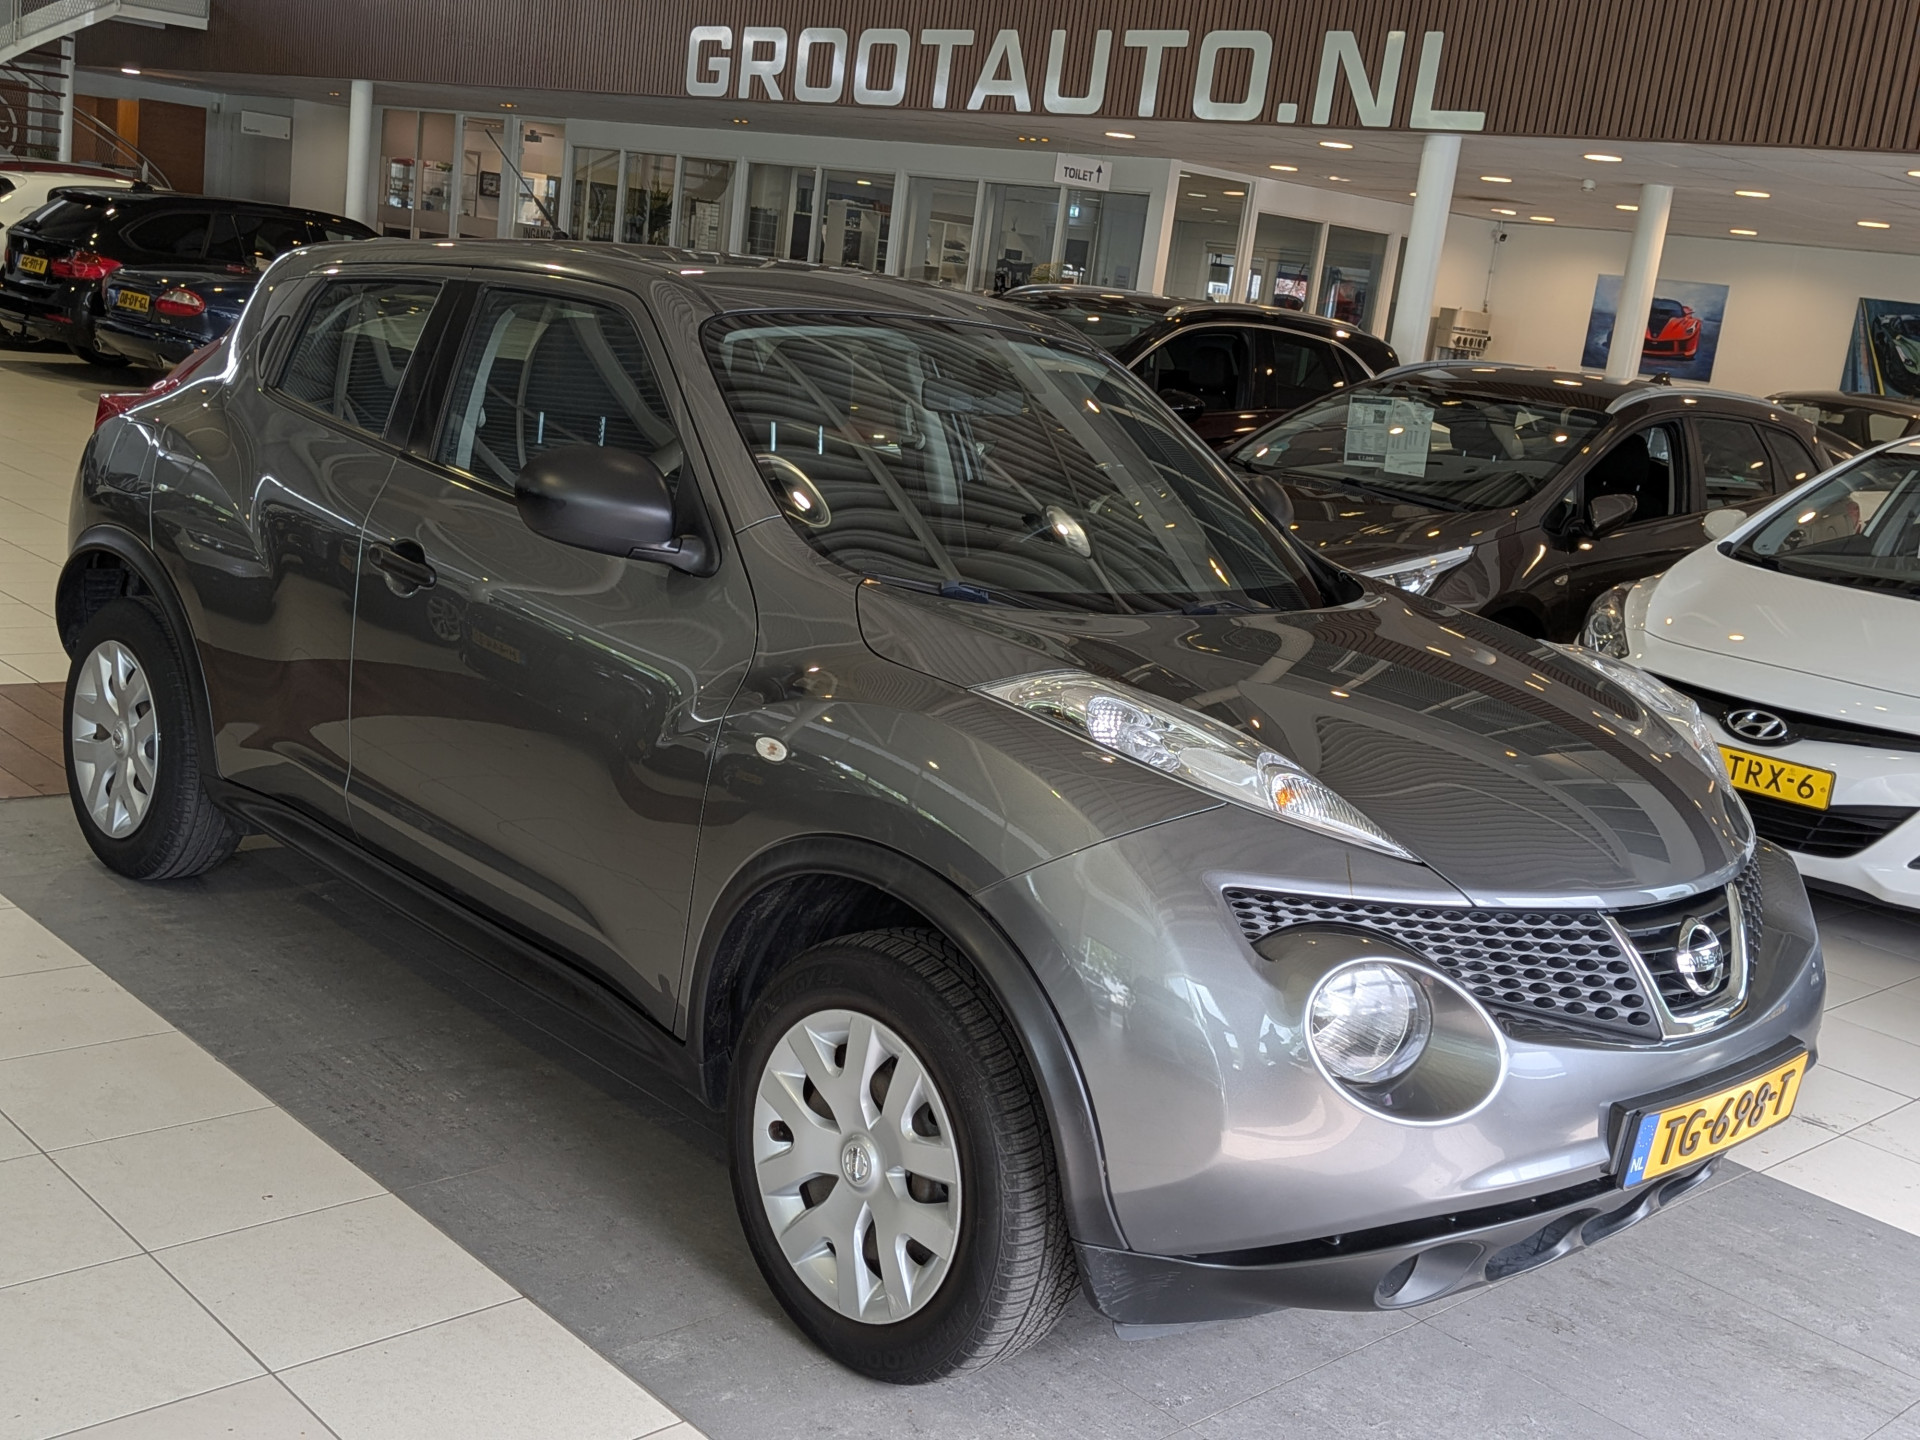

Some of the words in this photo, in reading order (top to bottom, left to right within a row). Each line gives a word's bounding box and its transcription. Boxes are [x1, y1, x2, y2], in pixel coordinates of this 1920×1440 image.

[685, 25, 1486, 132] GROOTAUTO.NL
[1063, 166, 1094, 182] TOILET
[1660, 1068, 1797, 1165] TG-698-T
[1630, 1156, 1644, 1174] NL
